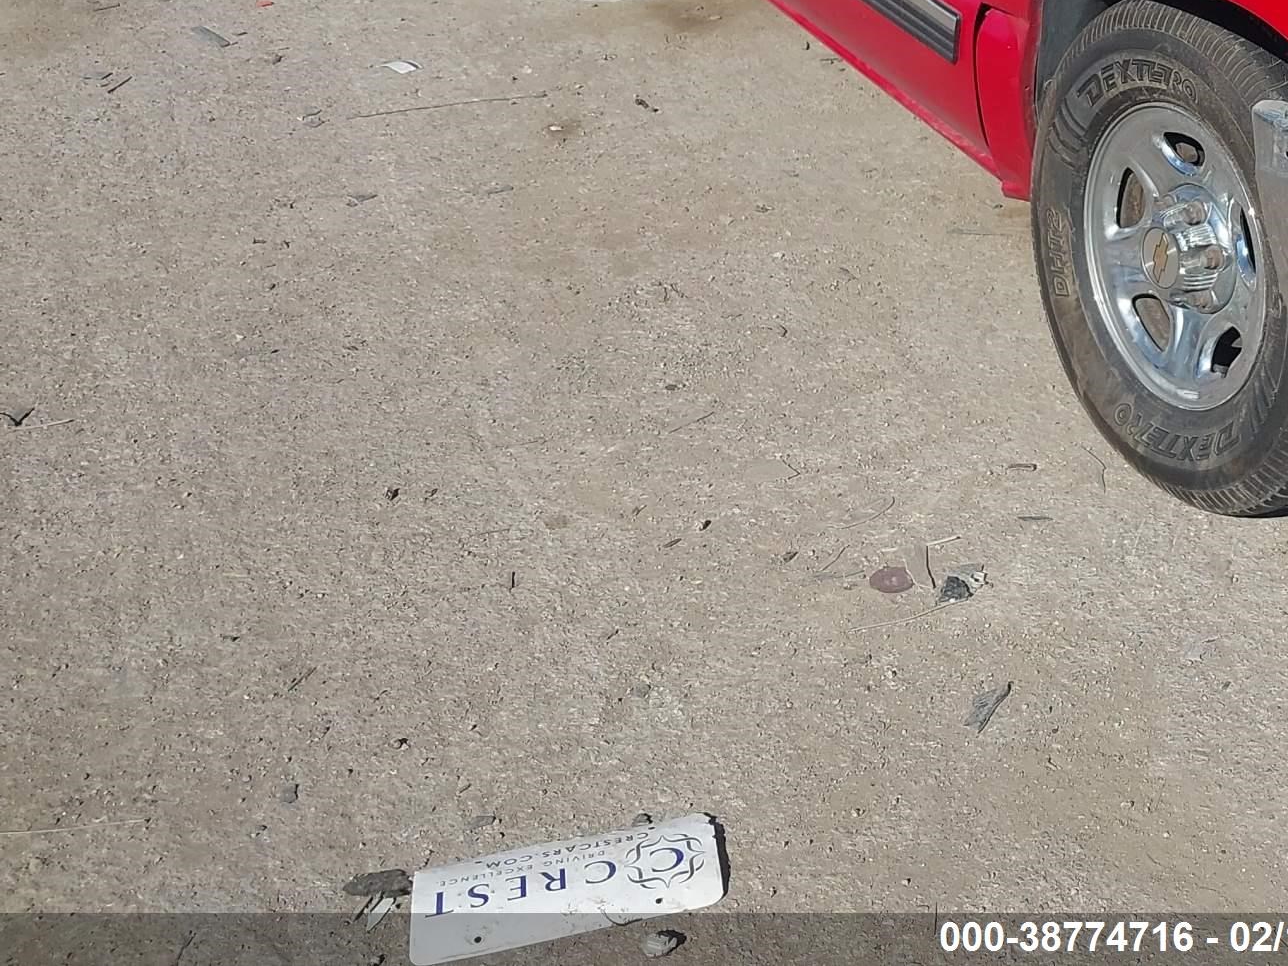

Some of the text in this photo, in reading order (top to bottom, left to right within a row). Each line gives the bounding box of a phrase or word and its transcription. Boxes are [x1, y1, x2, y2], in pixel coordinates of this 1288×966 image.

[1077, 58, 1200, 107] DEXTERO
[1114, 402, 1241, 462] DEXTERO
[486, 832, 649, 869] CRESTCARS.COM
[543, 850, 606, 868] DRIVING
[425, 860, 617, 918] CREST
